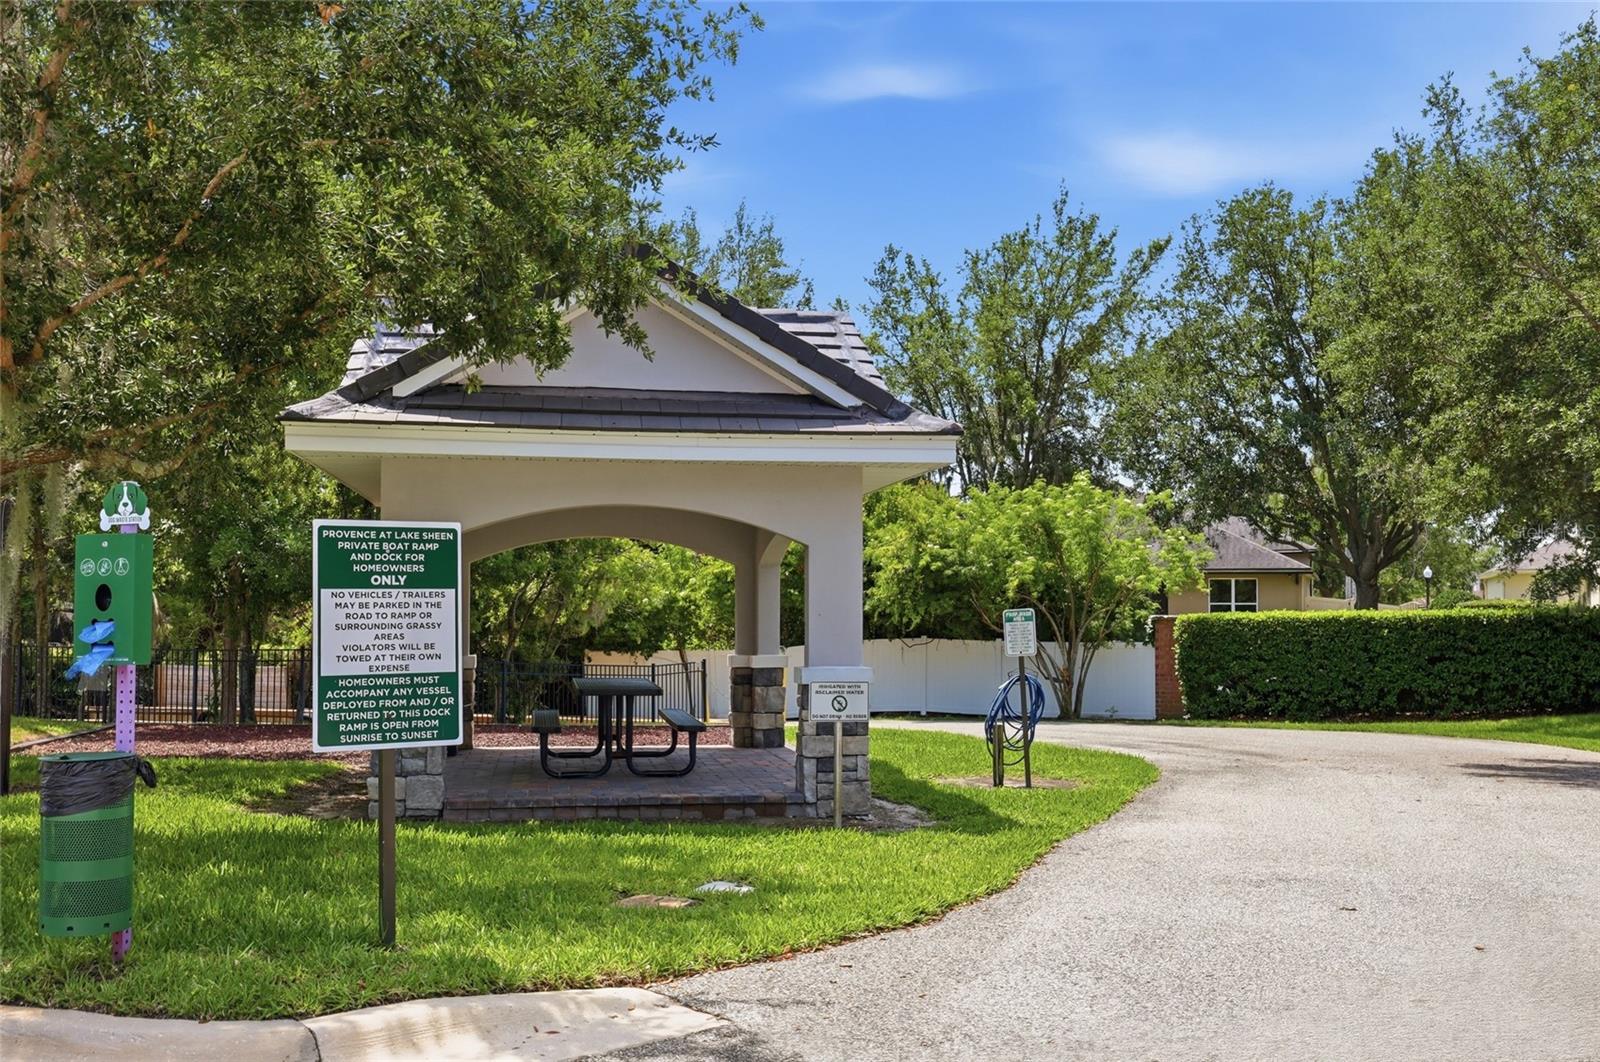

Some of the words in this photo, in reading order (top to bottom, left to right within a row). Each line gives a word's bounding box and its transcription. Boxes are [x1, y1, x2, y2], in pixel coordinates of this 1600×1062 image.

[322, 530, 376, 539] PROVENCE
[379, 531, 393, 539] AT
[395, 531, 420, 540] LAKE
[422, 532, 454, 540] SHEEN
[337, 541, 380, 550] PRIVATE
[382, 542, 409, 551] BOAT
[412, 543, 439, 551] RAMP
[350, 553, 372, 561] AND
[374, 553, 402, 561] DOCK
[405, 553, 425, 561] FOR
[353, 564, 425, 572] HOMEOWNERS
[370, 575, 407, 585] ONLY
[331, 591, 345, 599] NO
[348, 591, 393, 599] VEHICLES
[402, 591, 446, 599] TRAILERS
[373, 601, 410, 609] PARKED
[412, 601, 422, 609] IN
[424, 601, 442, 609] THE
[345, 612, 373, 620] ROAD
[375, 612, 388, 620] TO
[419, 611, 432, 619] OR
[335, 622, 404, 631] SURROUNDING
[406, 622, 442, 630] GRASSY
[374, 633, 405, 641] AREAS
[342, 643, 396, 652] VIOLATORS
[398, 643, 421, 651] WILL
[336, 655, 371, 663] TOWED
[374, 654, 387, 662] AT
[418, 653, 442, 661] OWN
[368, 664, 410, 673] EXPENSE
[338, 677, 411, 687] HOMEOWNERS
[413, 676, 440, 684] MUST
[326, 688, 390, 699] ACCOMPANY
[393, 687, 414, 696] ANY
[416, 686, 452, 695] VESSEL
[322, 700, 377, 710] DEPLOYED
[379, 699, 407, 708] FROM
[409, 698, 431, 706] AND
[440, 697, 455, 705] OR
[326, 711, 381, 721] RETURNED
[382, 710, 397, 719] TO
[399, 709, 421, 718] THIS
[423, 707, 451, 717] DOCK
[339, 722, 368, 732] RAMP
[370, 722, 380, 730] IS
[382, 721, 409, 730] OPEN
[411, 719, 439, 728] FROM
[340, 733, 383, 743] SUNRISE
[385, 732, 399, 741] TO
[401, 730, 439, 740] SUNSET
